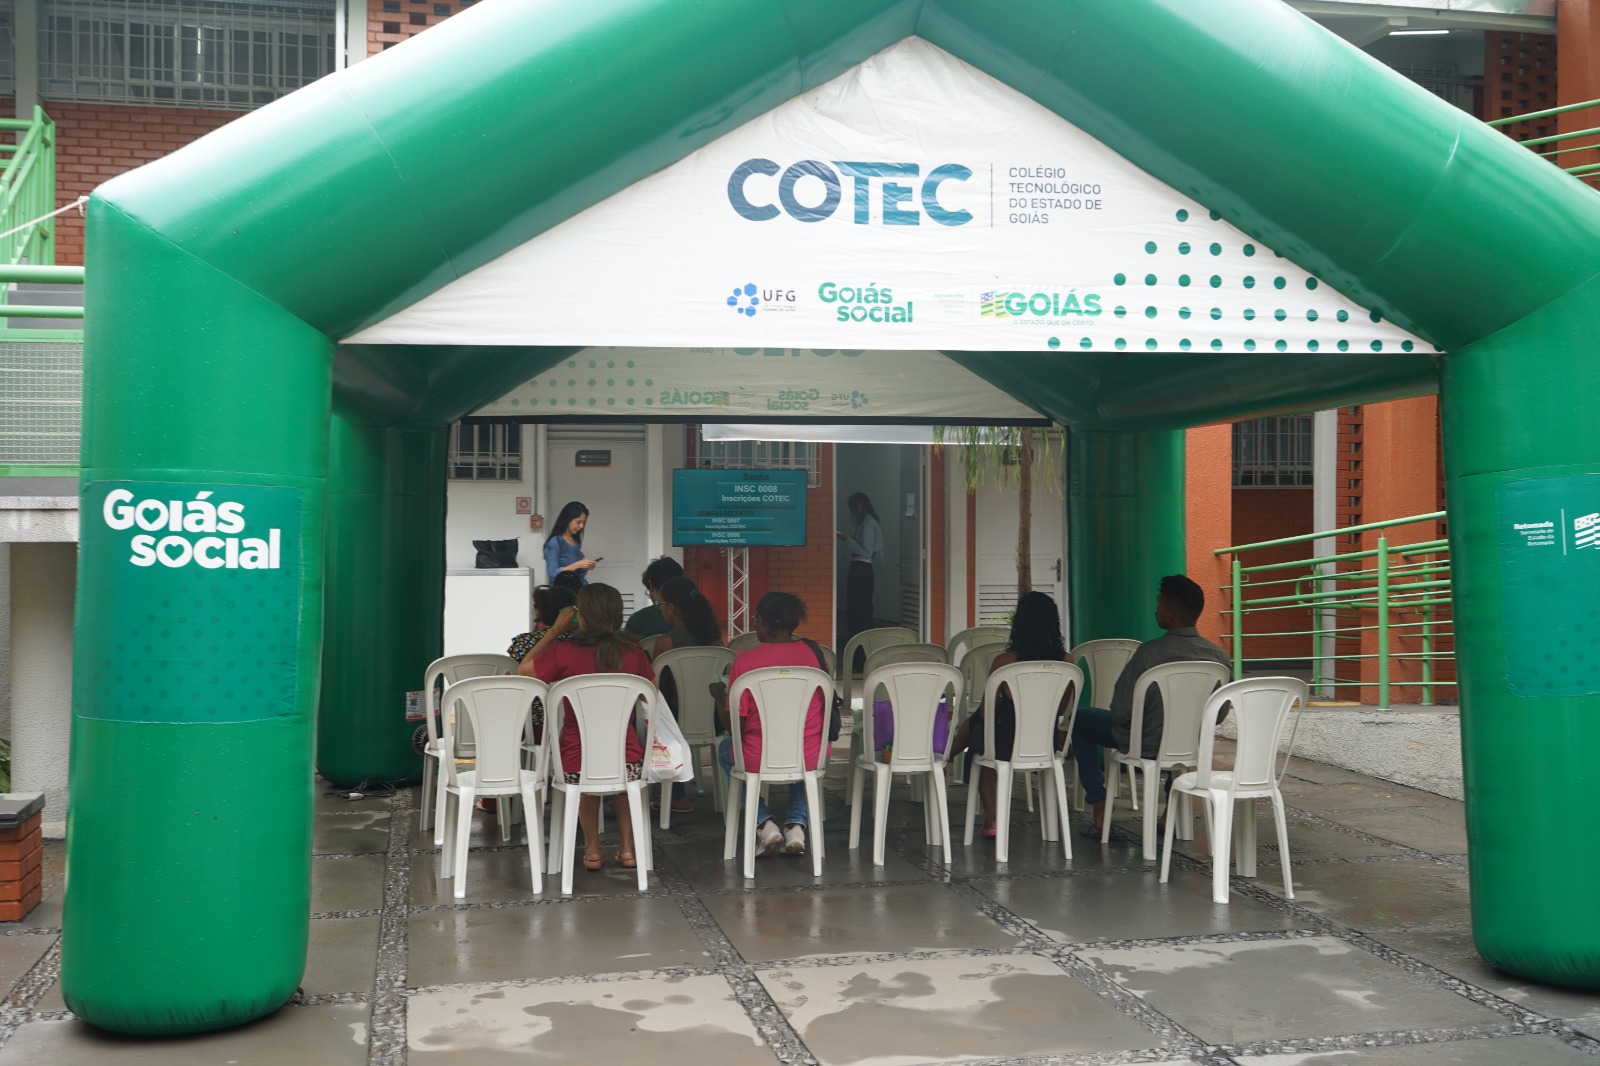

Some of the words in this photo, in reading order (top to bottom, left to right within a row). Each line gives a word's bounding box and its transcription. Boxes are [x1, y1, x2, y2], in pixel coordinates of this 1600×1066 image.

[1009, 165, 1066, 179] COLÉGIO
[727, 158, 973, 226] COTEC
[1009, 181, 1102, 195] TECNOLÓGICO
[1009, 198, 1027, 208] DO
[1031, 199, 1081, 210] ESTADO
[1085, 200, 1102, 210] DE
[1009, 211, 1049, 224] GOIÁS
[763, 290, 796, 301] UFG
[818, 282, 893, 304] Goiás
[1004, 289, 1103, 316] GOIÁS
[837, 301, 913, 322] social
[743, 473, 770, 481] Senha
[734, 485, 756, 493] INSC
[758, 485, 778, 493] 0008
[722, 495, 761, 503] Inscrições
[103, 489, 245, 534] Goiás
[1513, 521, 1554, 530] Retomada
[129, 528, 281, 569] social
